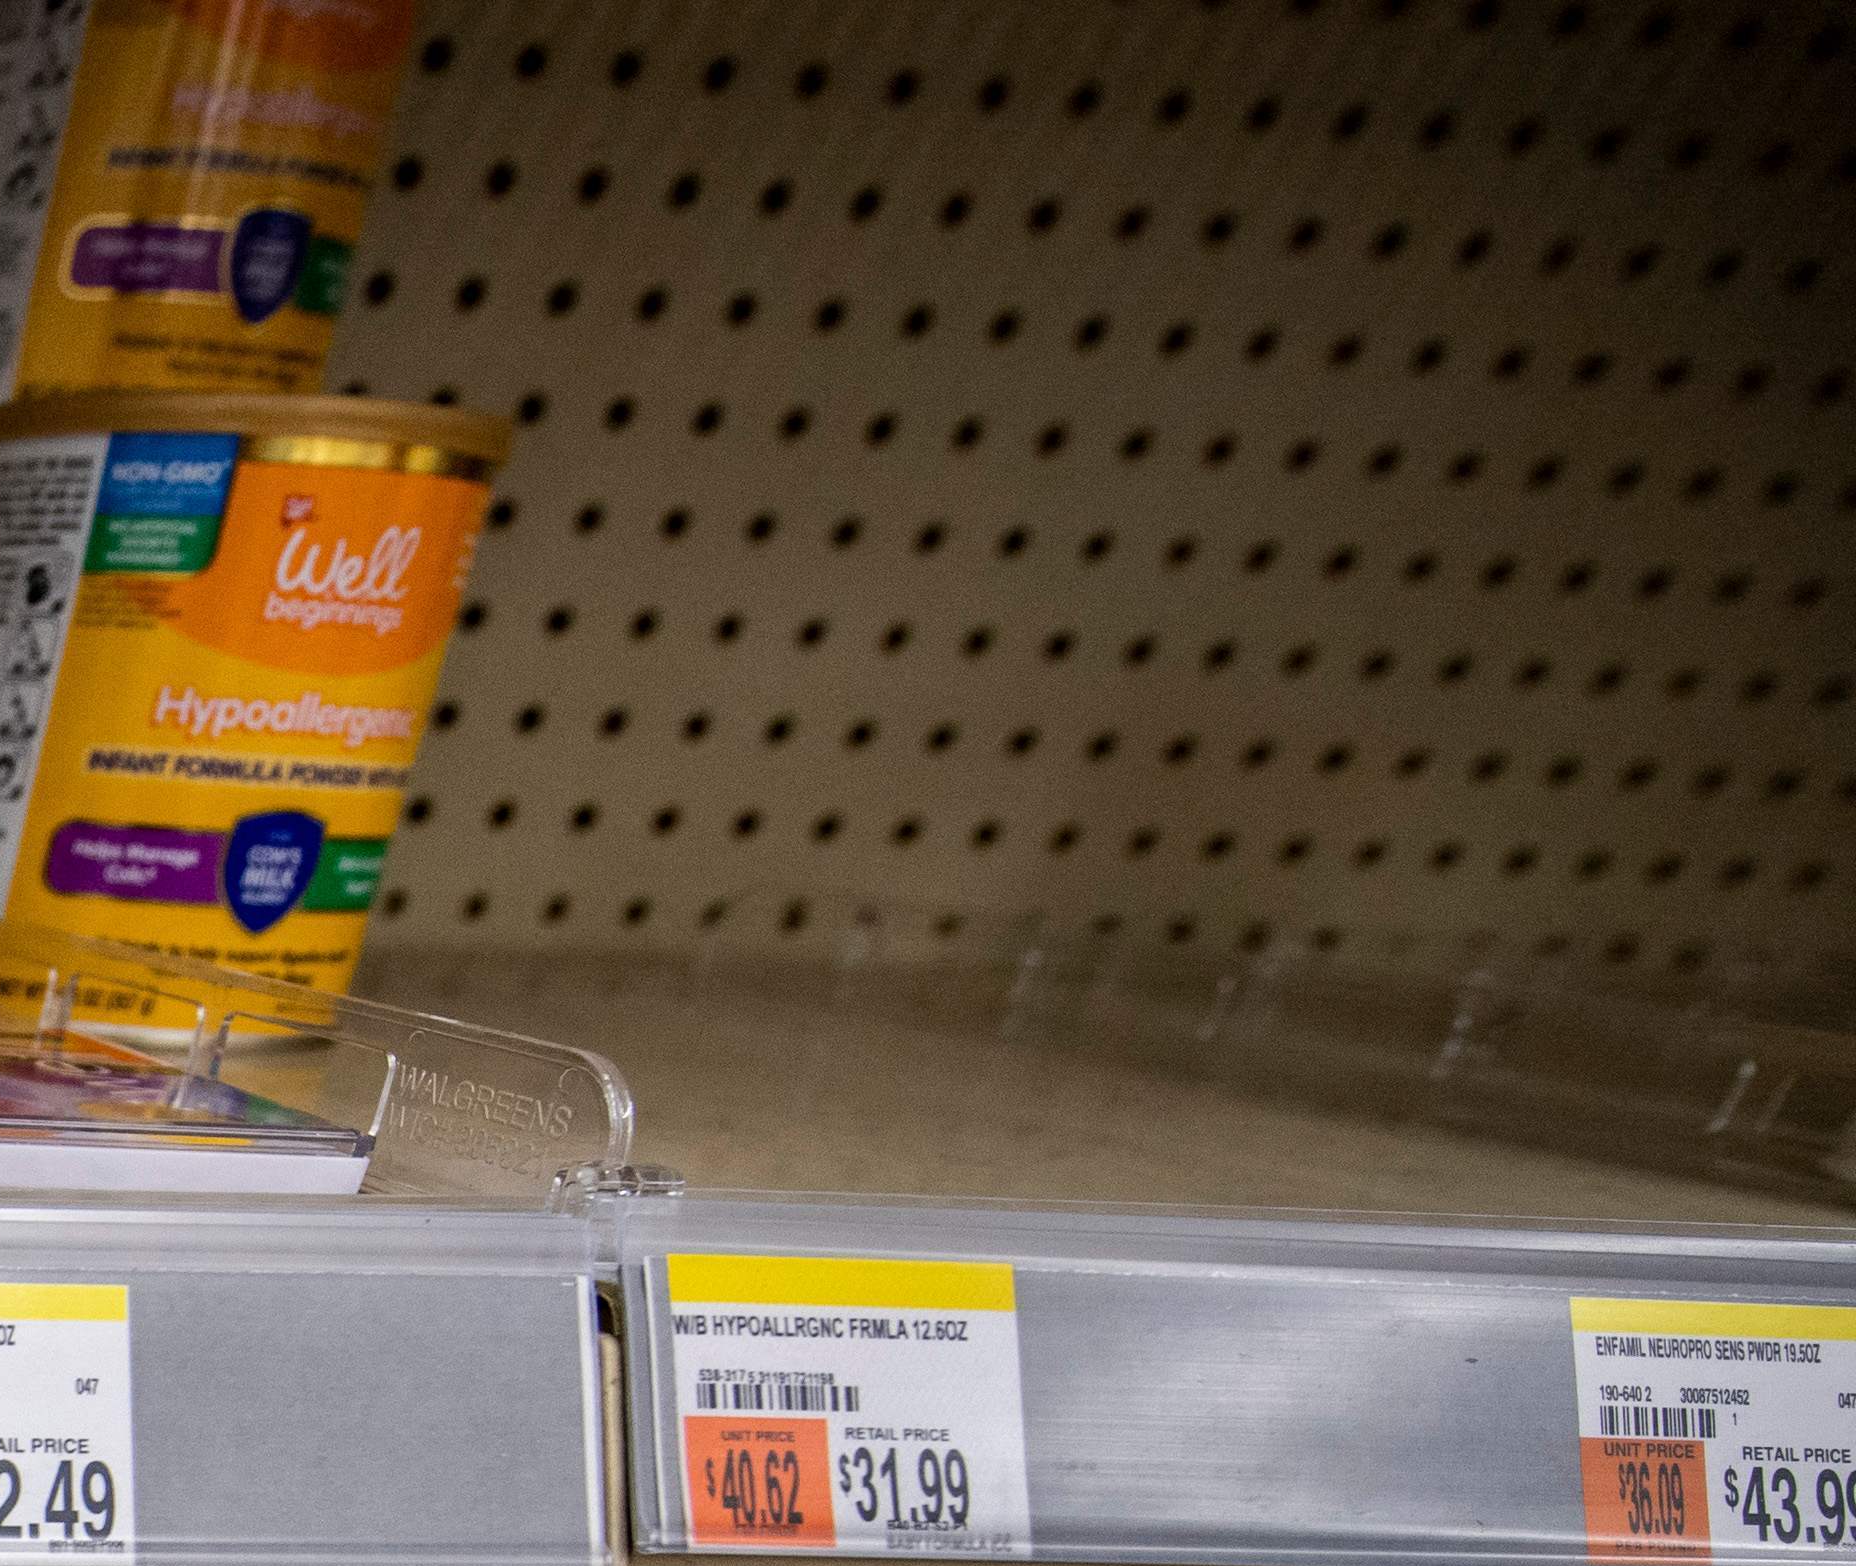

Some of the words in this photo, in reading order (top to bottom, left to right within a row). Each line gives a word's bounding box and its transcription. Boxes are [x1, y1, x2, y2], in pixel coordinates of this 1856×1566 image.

[276, 525, 423, 601] Well
[401, 1064, 573, 1139] WALGREENS
[712, 1315, 844, 1339] HYPOALLRGNC
[849, 1318, 908, 1340] FRMLA
[1595, 1336, 1646, 1357] ENFAMIL
[1648, 1338, 1712, 1360] NEUROPRO
[1715, 1340, 1745, 1360] SENS
[1748, 1342, 1781, 1362] PWDR
[844, 1427, 898, 1441] RETAIL
[903, 1428, 949, 1442] PRICE
[1743, 1447, 1799, 1462] RETAIL
[1804, 1448, 1851, 1463] PRICE
[705, 1448, 803, 1527] $40.62
[839, 1447, 969, 1524] $31.99
[1619, 1461, 1684, 1536] $36.09
